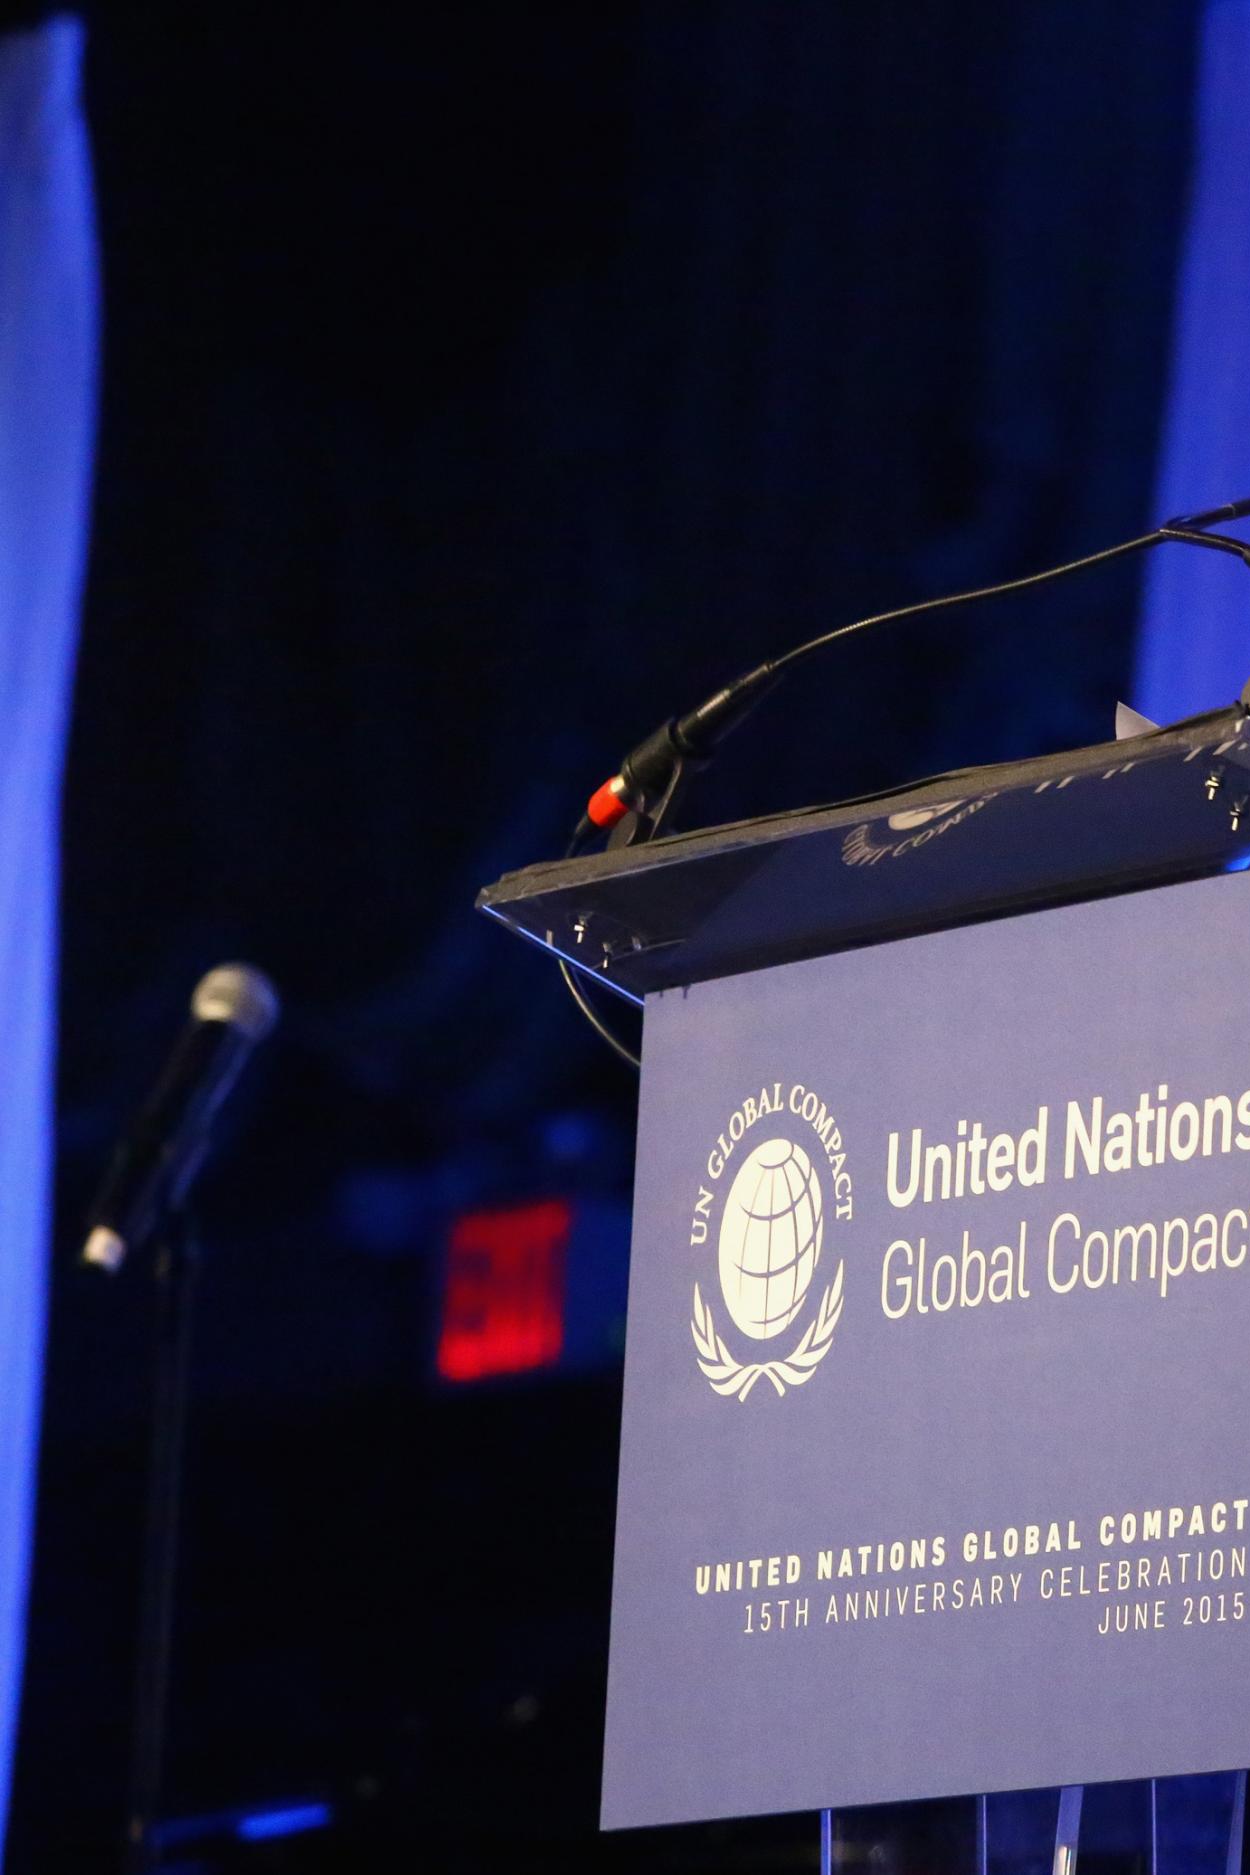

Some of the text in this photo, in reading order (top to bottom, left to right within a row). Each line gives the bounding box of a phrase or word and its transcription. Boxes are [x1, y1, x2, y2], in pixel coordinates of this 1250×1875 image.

[690, 1082, 853, 1247] UN GLOBAL COMPACT
[886, 1105, 1049, 1209] United
[880, 1220, 1031, 1320] Global
[695, 1498, 1250, 1596] UNITED NATIONS GLOBAL COMPACT
[743, 1546, 1247, 1635] 15TH ANNIVERSARY CELEBRATION
[1097, 1591, 1246, 1636] JUNE 2015
